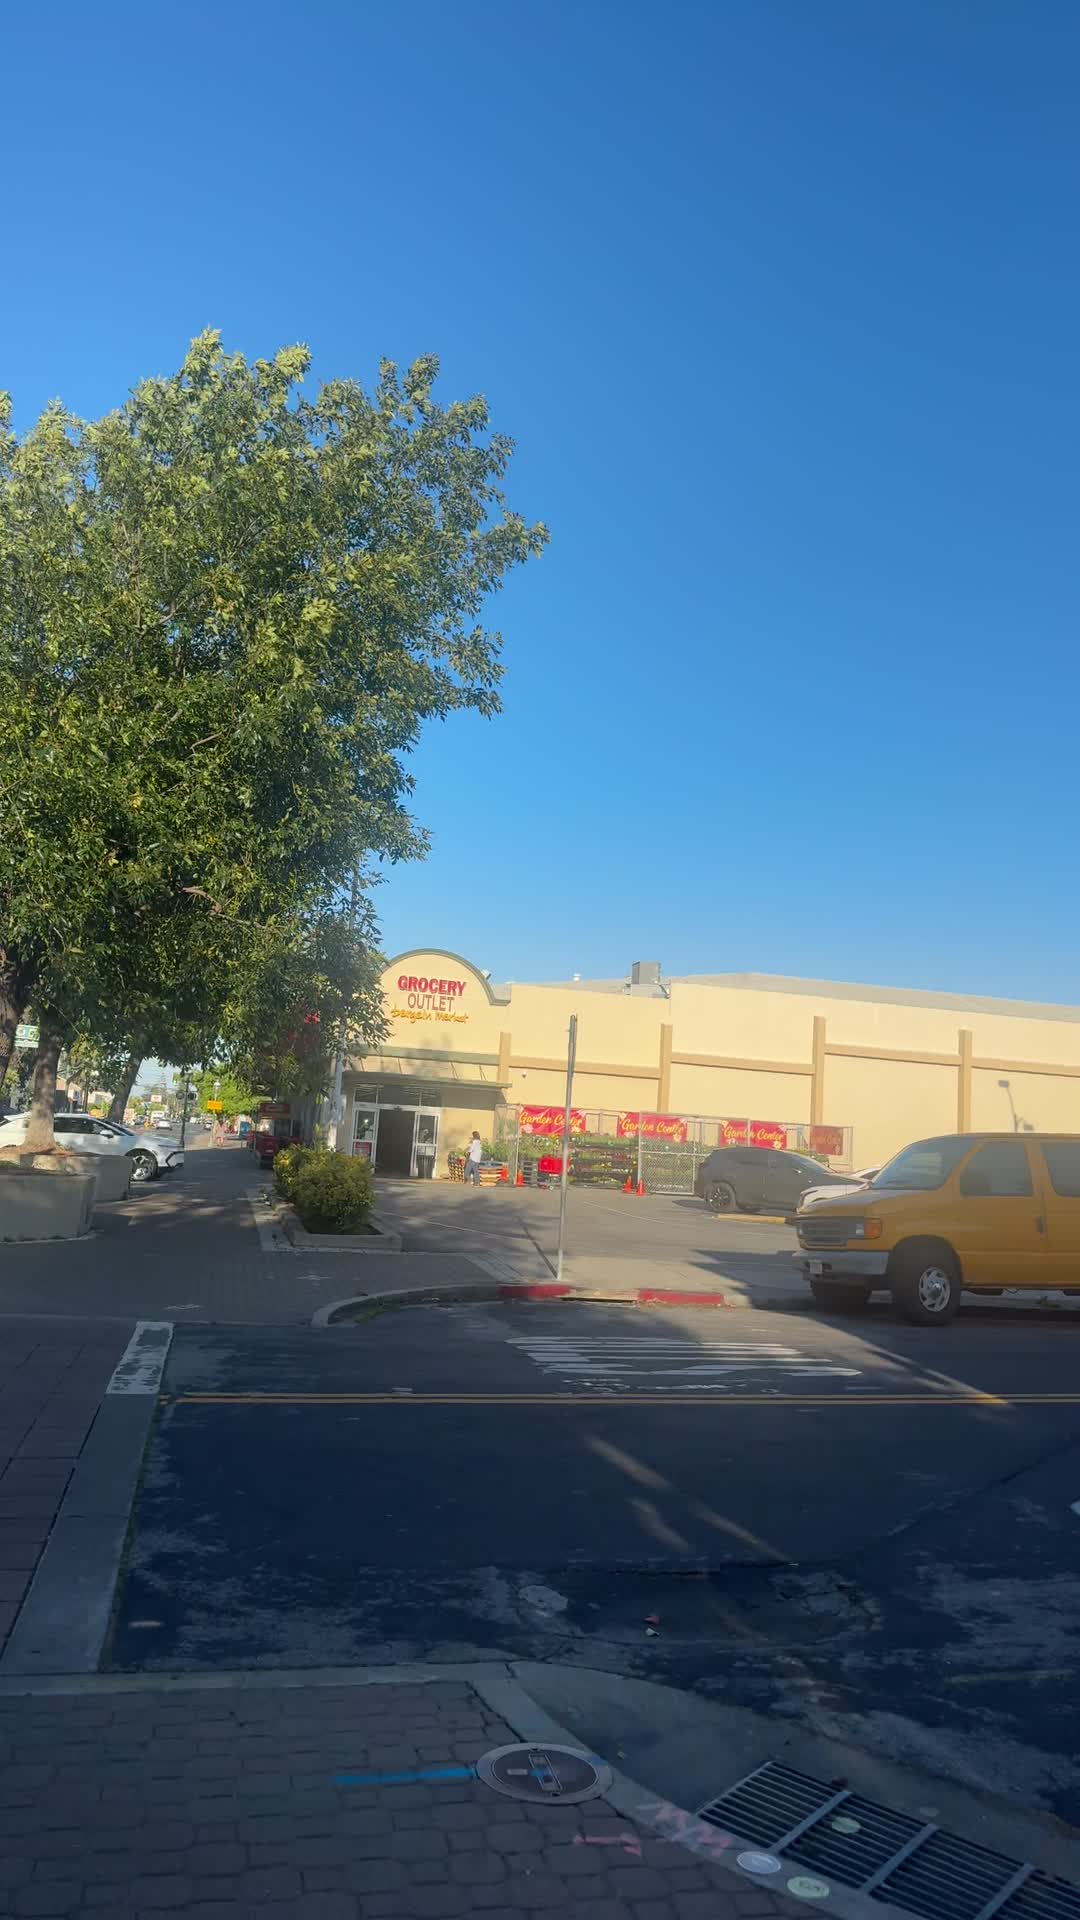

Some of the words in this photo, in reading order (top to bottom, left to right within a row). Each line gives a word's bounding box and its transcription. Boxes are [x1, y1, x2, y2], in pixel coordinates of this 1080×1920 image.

[397, 975, 467, 996] GROCERY
[407, 993, 455, 1012] OUTLET
[519, 1111, 551, 1125] Garden
[656, 1120, 684, 1134] Center
[757, 1128, 784, 1141] Center
